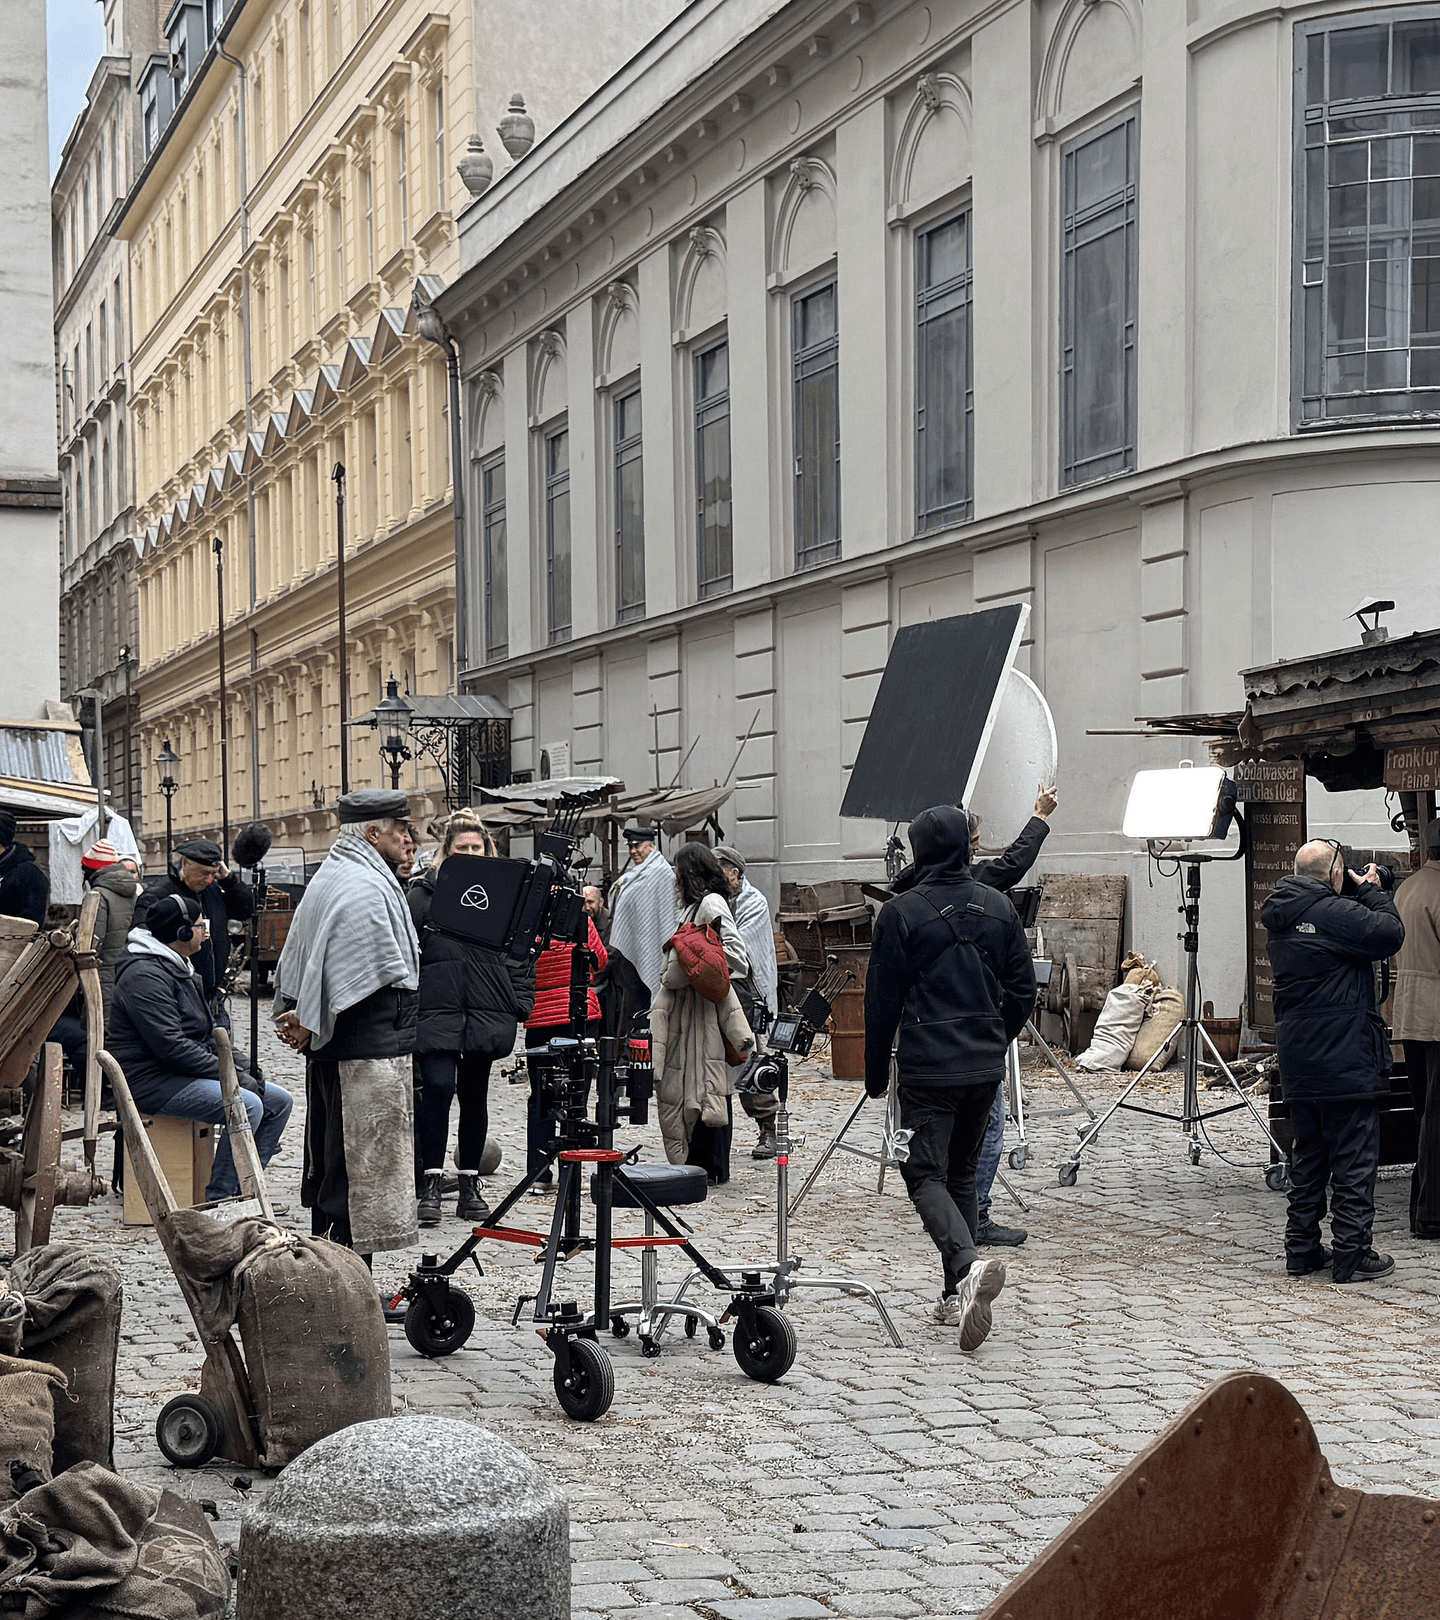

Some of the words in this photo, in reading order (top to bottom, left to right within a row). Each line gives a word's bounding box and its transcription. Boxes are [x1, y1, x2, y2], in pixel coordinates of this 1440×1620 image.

[1237, 763, 1299, 781] Sodawasser
[1401, 770, 1430, 789] Feine
[1252, 782, 1274, 800] Glas
